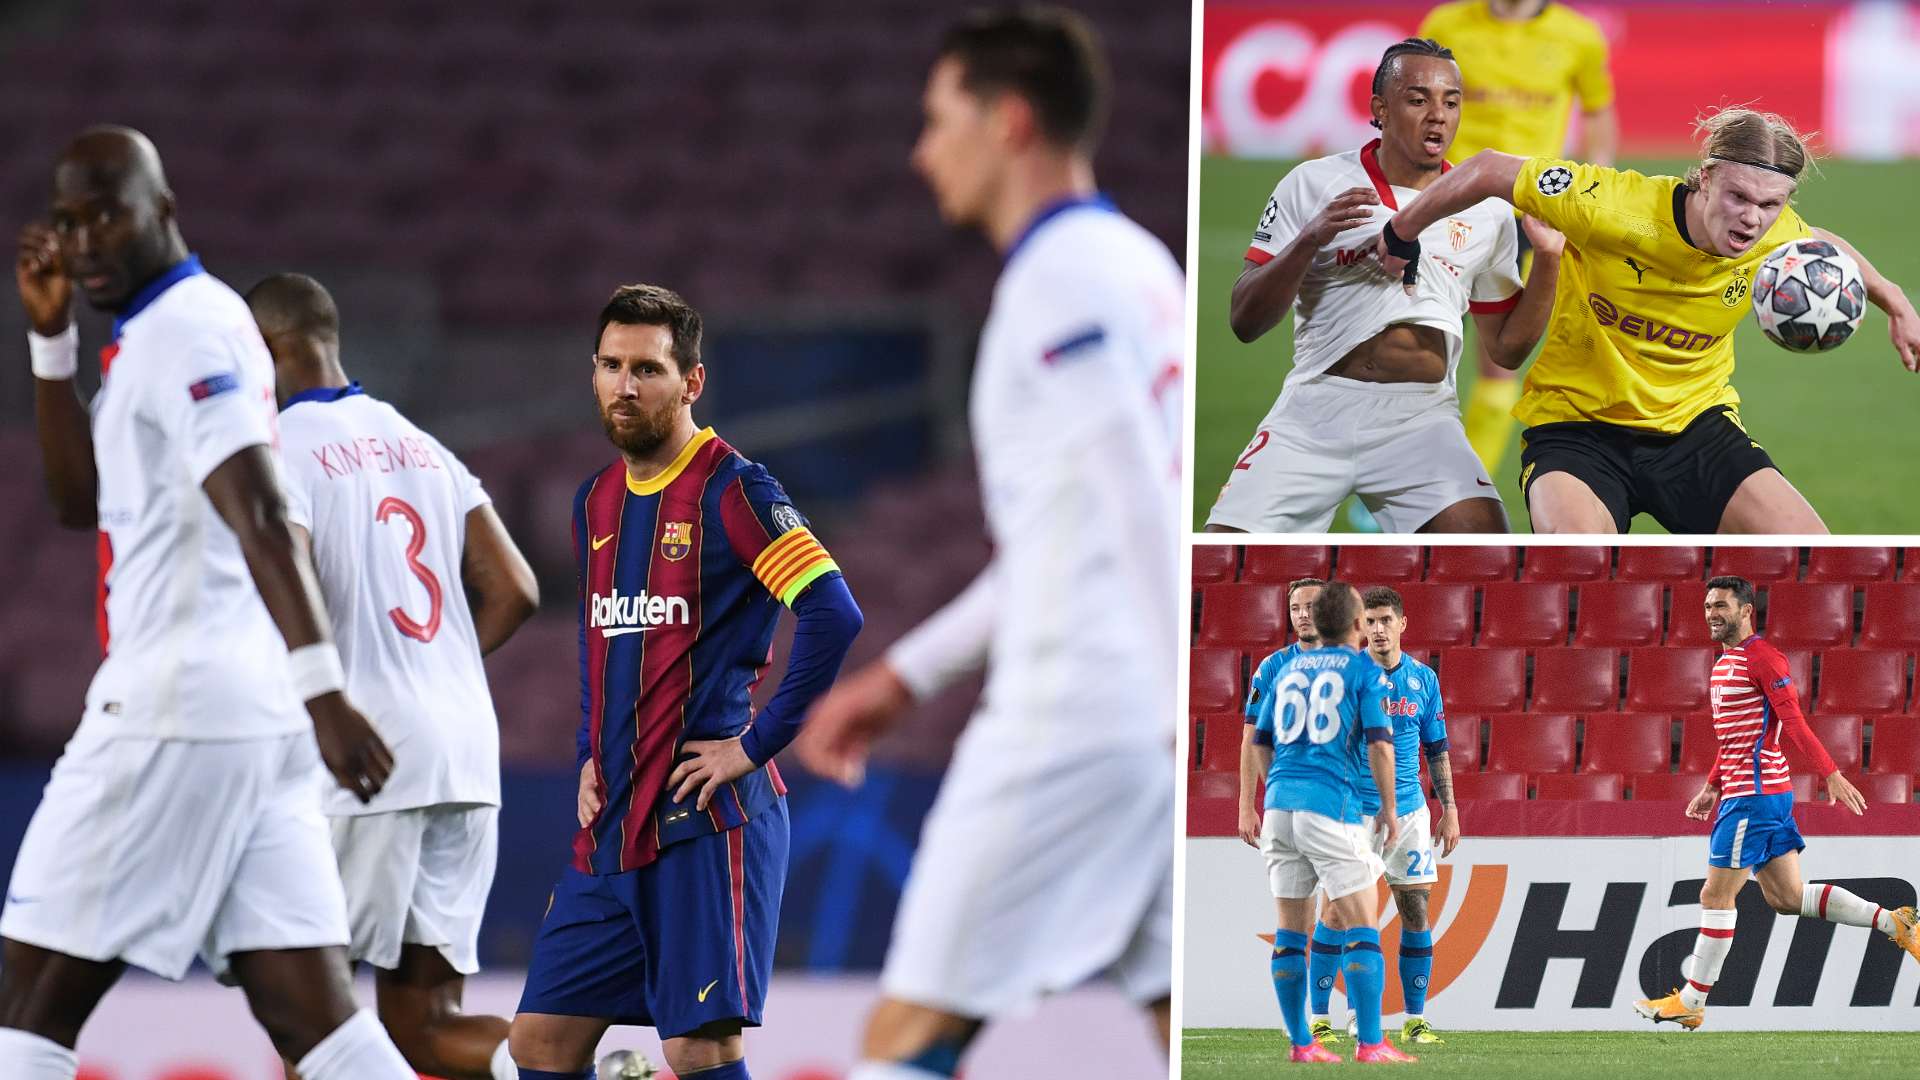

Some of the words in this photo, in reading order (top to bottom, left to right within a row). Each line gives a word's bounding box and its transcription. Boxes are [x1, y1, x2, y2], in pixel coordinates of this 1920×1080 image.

[1724, 280, 1747, 298] BVB
[375, 496, 443, 643] 3
[590, 588, 690, 628] Rakuten
[1289, 653, 1350, 671] LOBOTKA
[1274, 670, 1345, 745] 68
[1388, 695, 1419, 718] ete
[1406, 849, 1434, 877] 22
[1494, 877, 1920, 1008] Han
